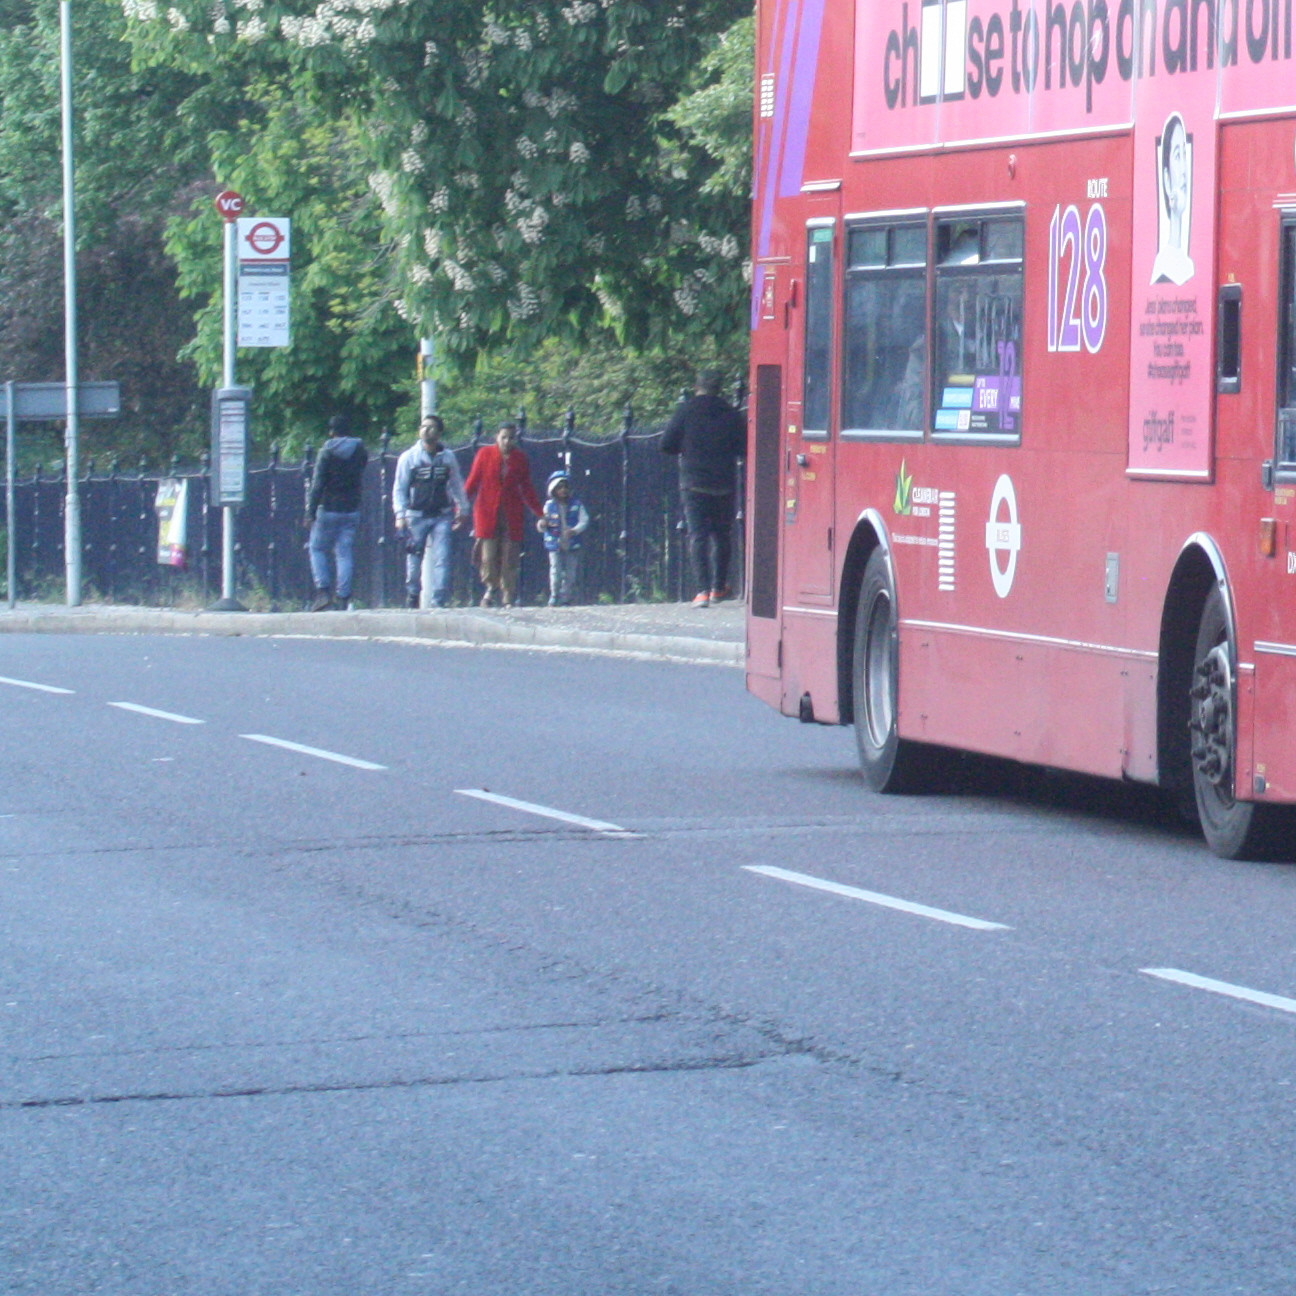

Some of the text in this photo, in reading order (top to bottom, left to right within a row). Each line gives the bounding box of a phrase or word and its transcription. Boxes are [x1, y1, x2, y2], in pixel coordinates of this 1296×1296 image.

[1087, 178, 1108, 198] ROUTE
[220, 198, 241, 211] VC
[1047, 202, 1107, 354] 128
